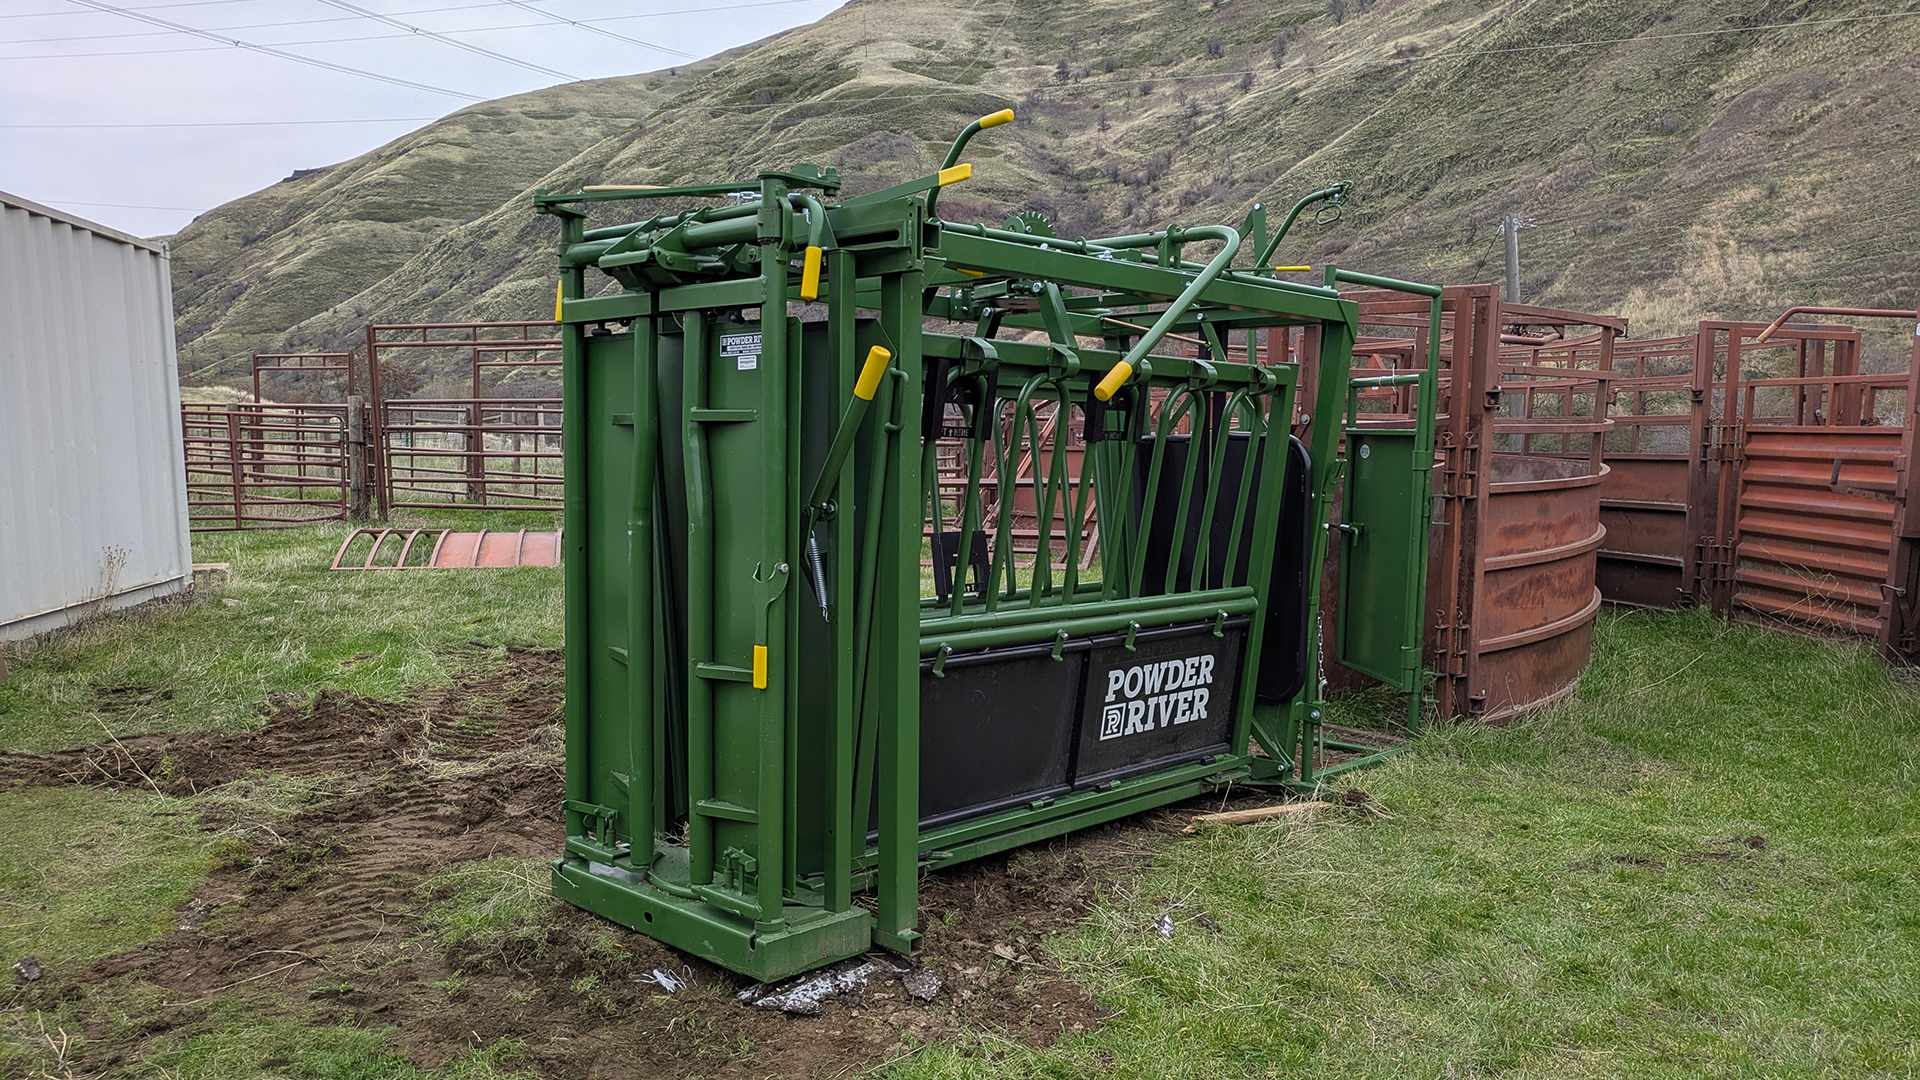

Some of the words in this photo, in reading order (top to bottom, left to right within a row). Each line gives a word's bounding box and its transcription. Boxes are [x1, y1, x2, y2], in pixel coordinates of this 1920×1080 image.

[727, 336, 753, 345] POWDER
[1105, 654, 1215, 703] POWDER
[1124, 687, 1210, 736] RIVER
